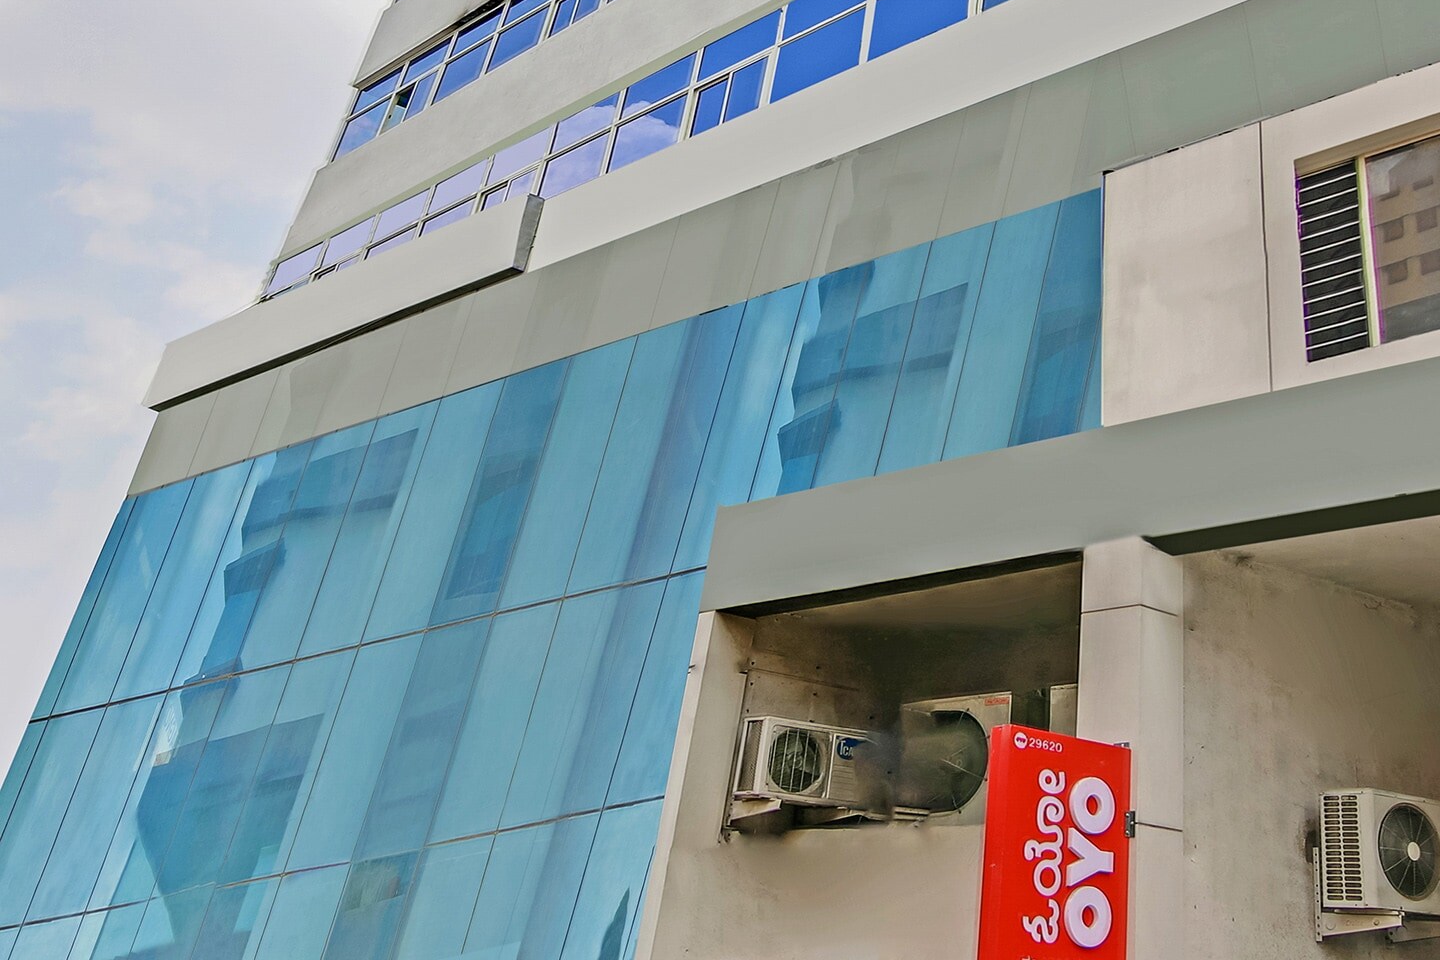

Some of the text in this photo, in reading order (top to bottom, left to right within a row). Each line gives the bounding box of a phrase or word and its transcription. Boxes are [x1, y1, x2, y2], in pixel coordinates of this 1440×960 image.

[1029, 738, 1063, 753] 29620
[1022, 768, 1066, 944] ಓಯೋ
[1064, 776, 1116, 948] OYO
